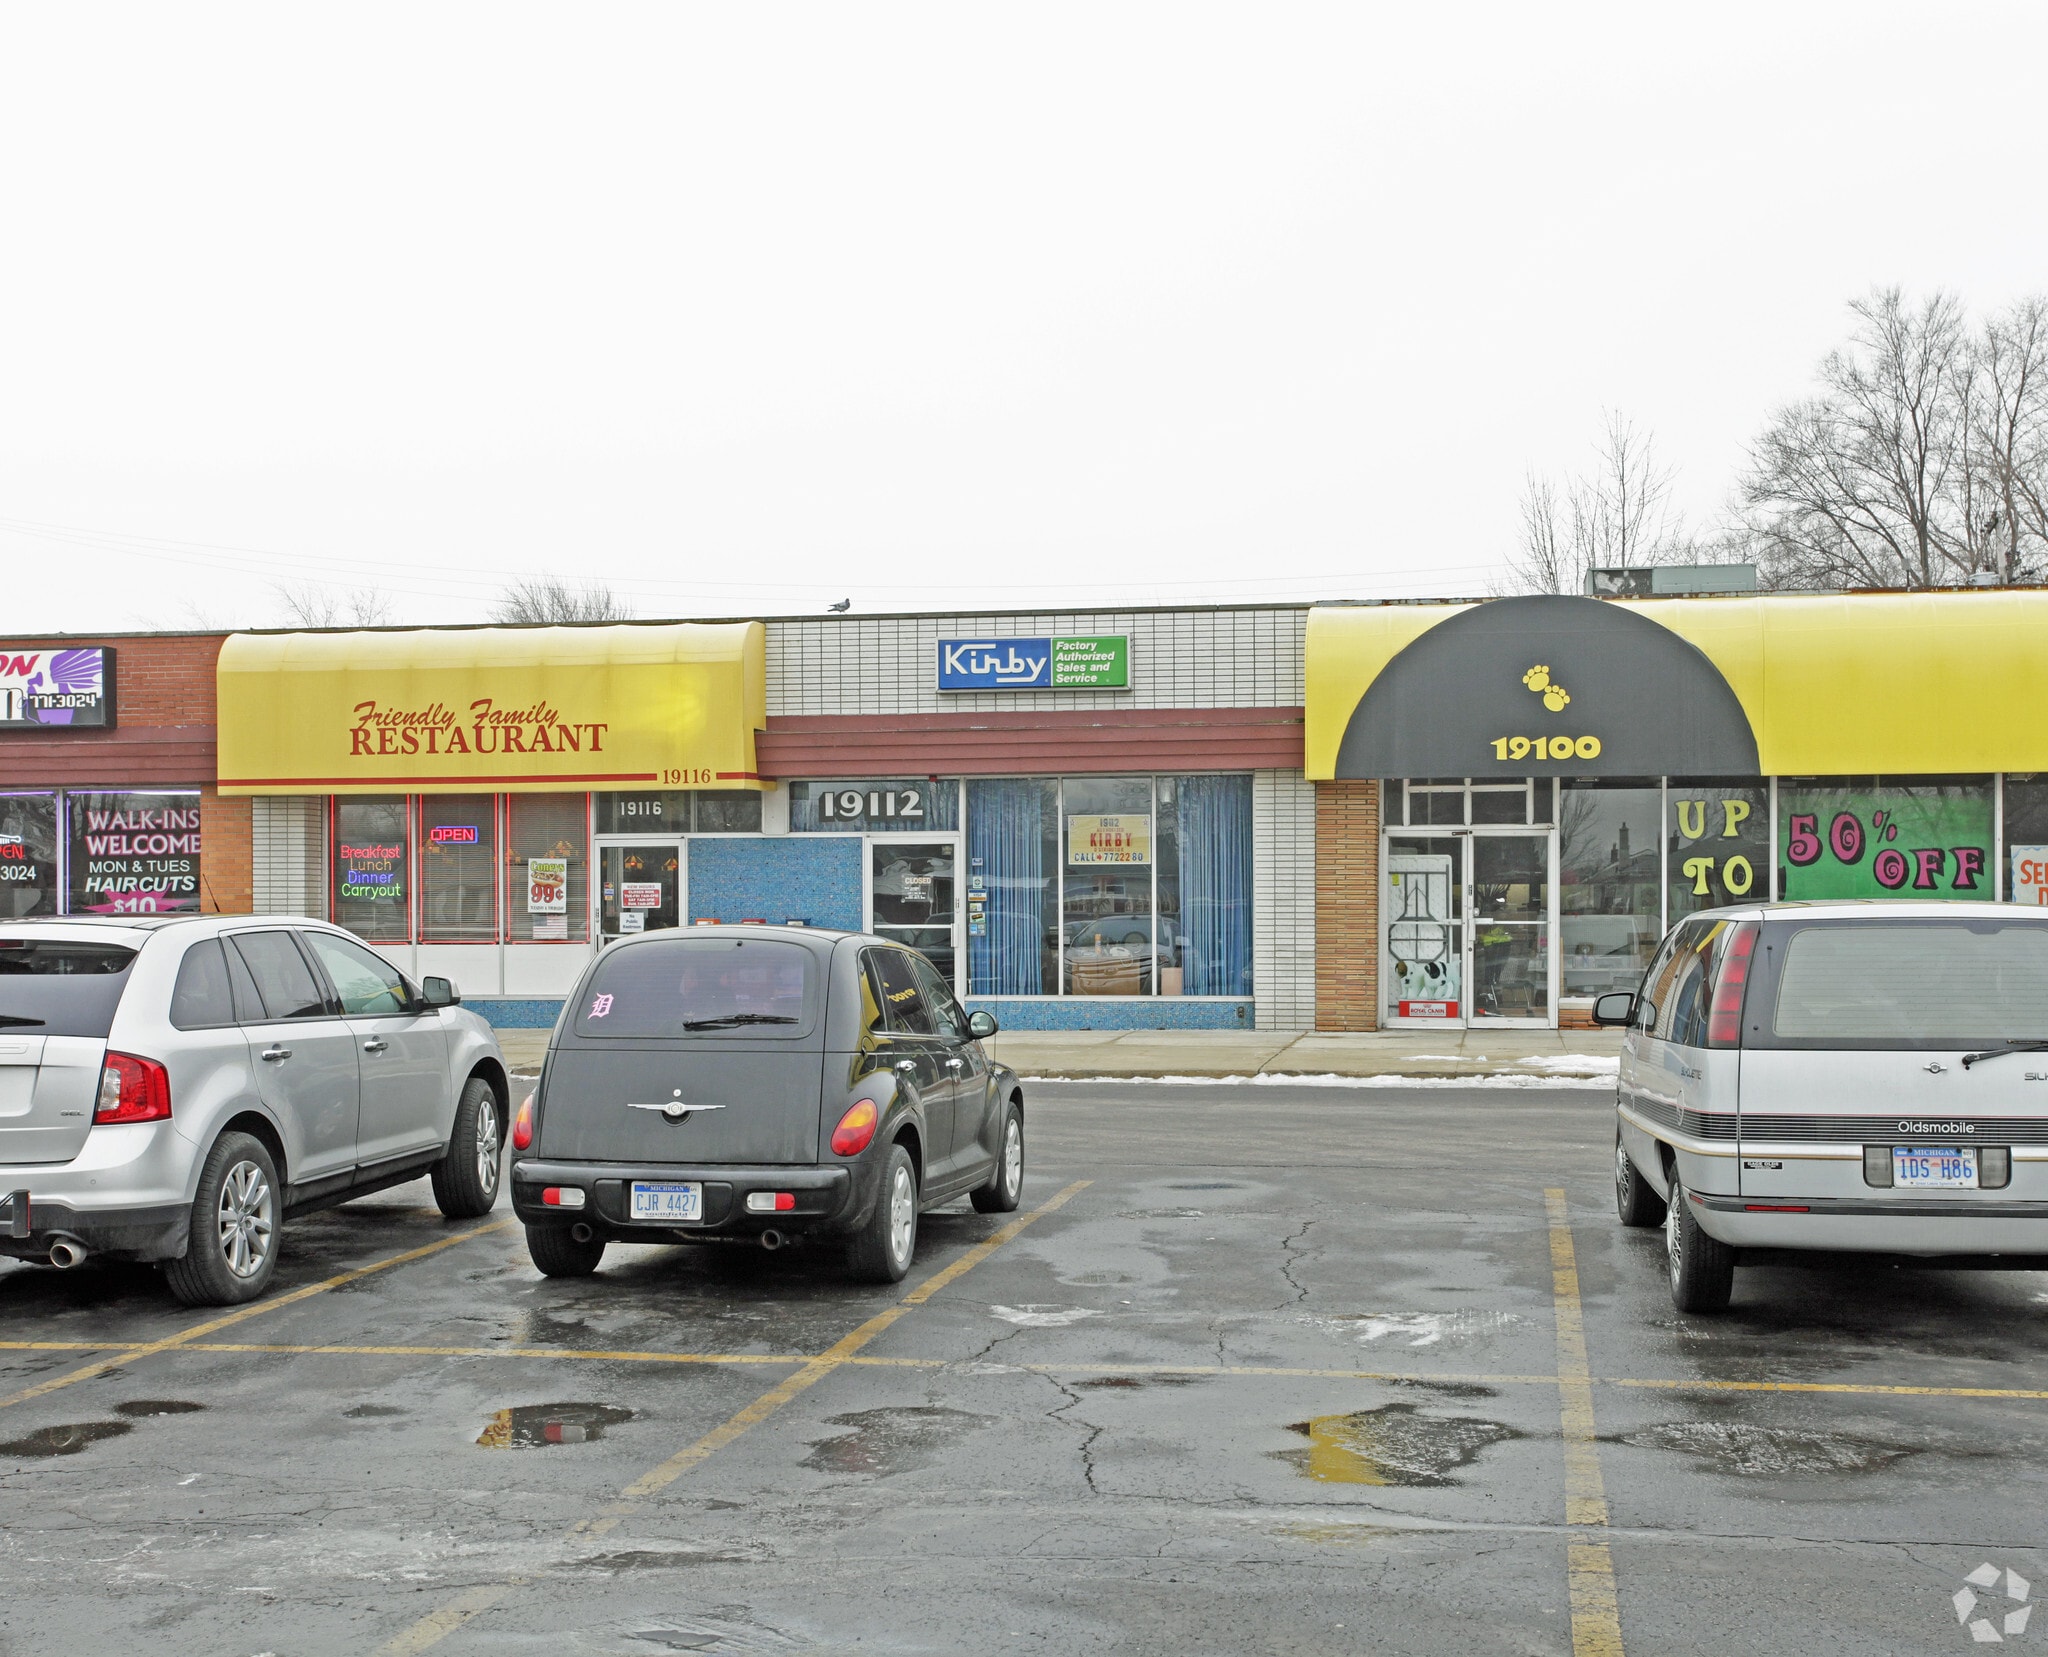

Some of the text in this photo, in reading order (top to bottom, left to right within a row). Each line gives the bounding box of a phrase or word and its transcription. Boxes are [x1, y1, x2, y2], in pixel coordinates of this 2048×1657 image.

[1056, 641, 1097, 652] Factory
[945, 643, 1047, 683] Kirby
[1056, 651, 1115, 662] Authorized
[1056, 662, 1111, 672] Sales and
[1056, 673, 1098, 683] Service
[353, 698, 560, 731] Friendly Family
[349, 723, 608, 756] RESTAURANT
[1490, 736, 1602, 761] 19100
[662, 769, 712, 785] 19116
[620, 801, 662, 816] 19116
[823, 790, 924, 818] 19112
[87, 809, 200, 832] WALK-INS
[1675, 799, 1751, 840] UP
[430, 827, 476, 841] OPEN
[1090, 833, 1132, 847] KIRBY
[1786, 808, 1898, 868] 50%
[85, 833, 201, 856] WELCOME
[340, 845, 401, 859] Breakfast
[1074, 852, 1096, 861] CALL
[89, 860, 190, 873] MON & TUES
[350, 859, 392, 871] Lunch
[530, 860, 565, 873] Coneys
[1872, 845, 1986, 891] OFF
[348, 870, 394, 884] Dinner
[905, 877, 931, 885] CLOSED
[1682, 855, 1754, 896] TO
[85, 875, 196, 893] HAIRCUTS
[341, 883, 401, 900] Carryout
[113, 896, 157, 913] $10
[1898, 1121, 1975, 1134] Oldsmobile
[1914, 1148, 1956, 1156] MICHIGAN
[1900, 1158, 1972, 1179] 1DS H86
[636, 1193, 697, 1212] CJR 4427
